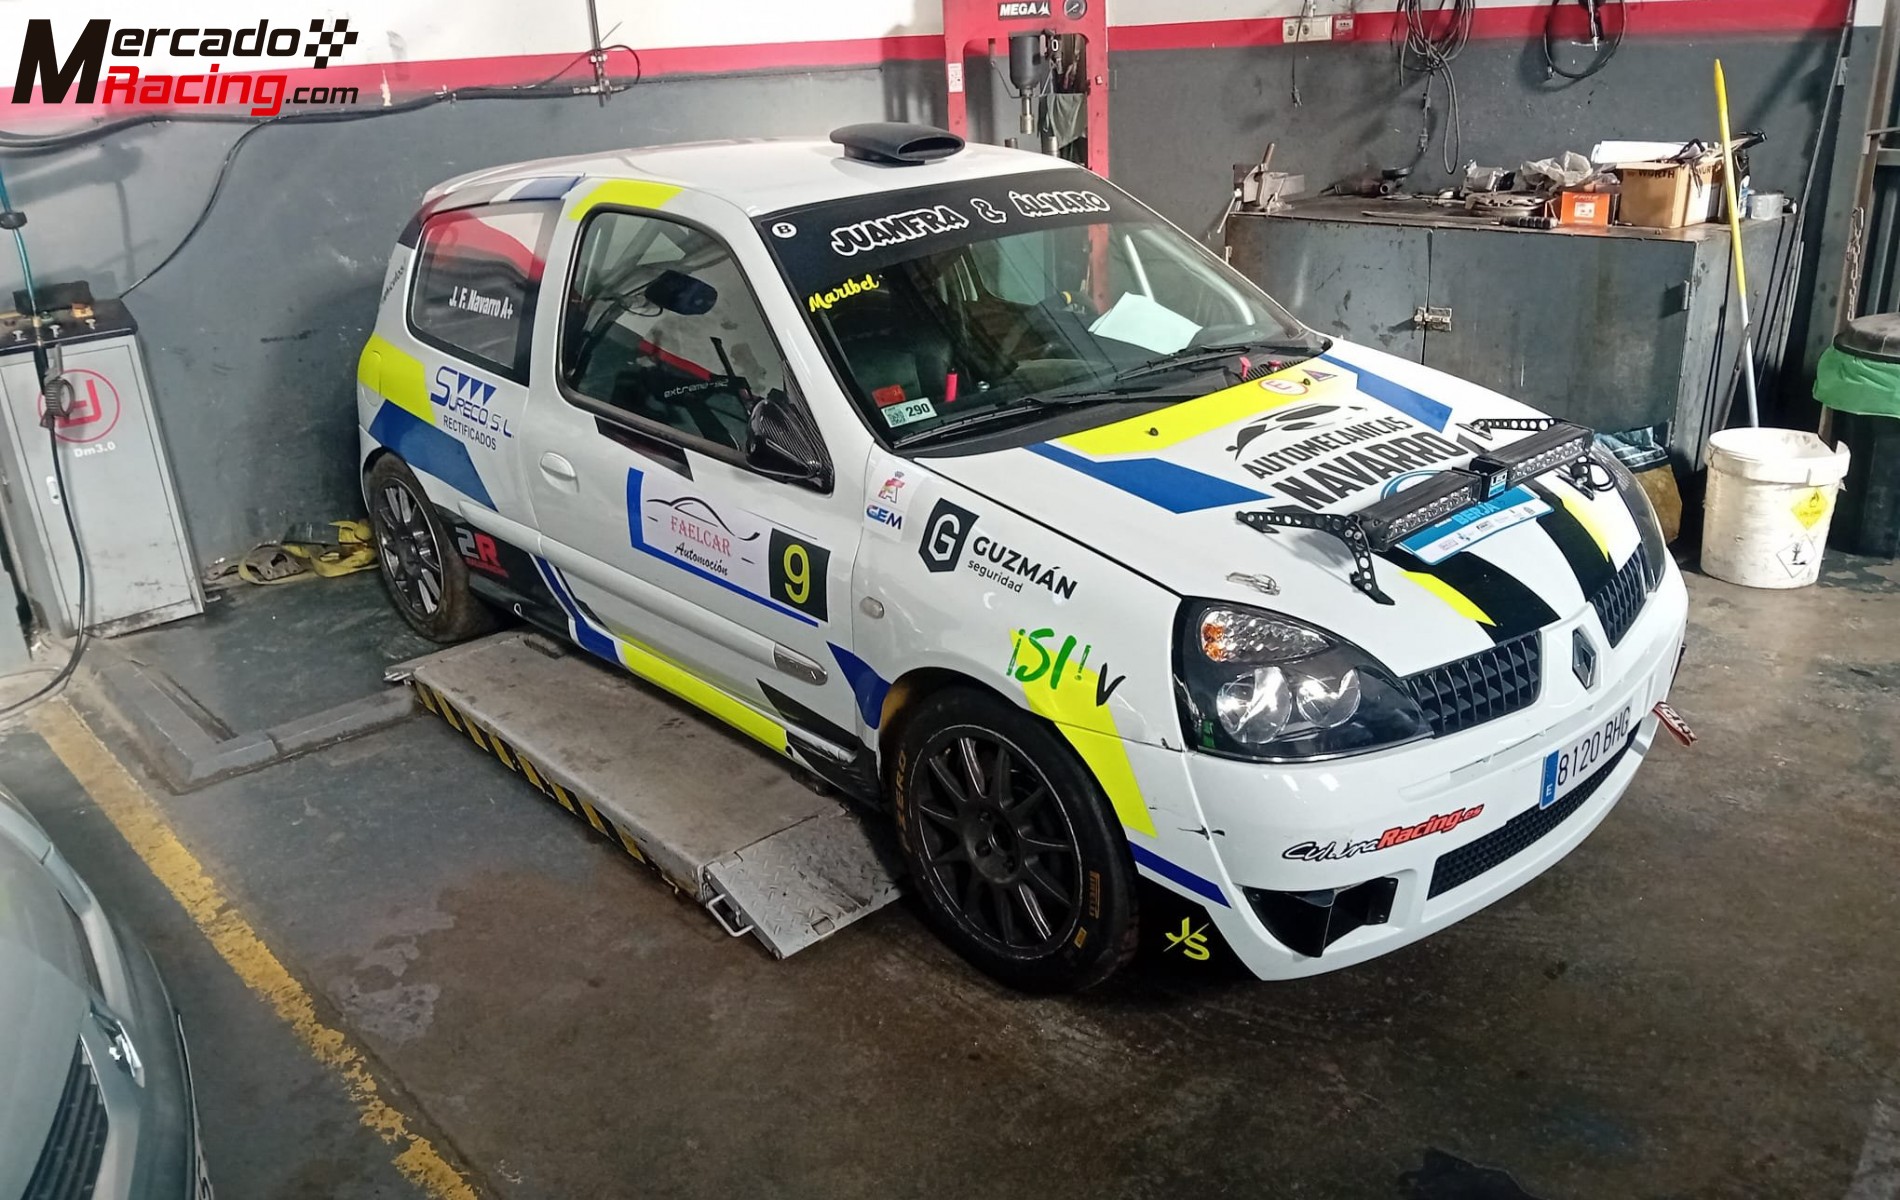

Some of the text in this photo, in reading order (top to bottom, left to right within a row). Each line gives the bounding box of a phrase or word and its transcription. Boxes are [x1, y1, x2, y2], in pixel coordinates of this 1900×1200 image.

[1000, 3, 1037, 16] MEGA
[831, 190, 1111, 256] JUANFRA & ÁLVARO
[467, 290, 501, 317] Navarro
[809, 273, 880, 312] Maribel
[906, 403, 930, 417] 290
[73, 441, 116, 458] Dm3.0
[443, 414, 497, 451] RECTIFICADOS
[1242, 416, 1414, 480] AUTOMECANICAS
[1271, 431, 1469, 511] NAVARRO
[670, 515, 732, 557] FAELCAR
[674, 542, 729, 576] Automoción
[783, 544, 810, 604] 9
[967, 559, 1023, 593] seguridad
[973, 536, 1078, 600] GUZMÁN
[1558, 731, 1601, 786] 8120
[1603, 706, 1631, 754] BHG
[1546, 783, 1553, 797] E
